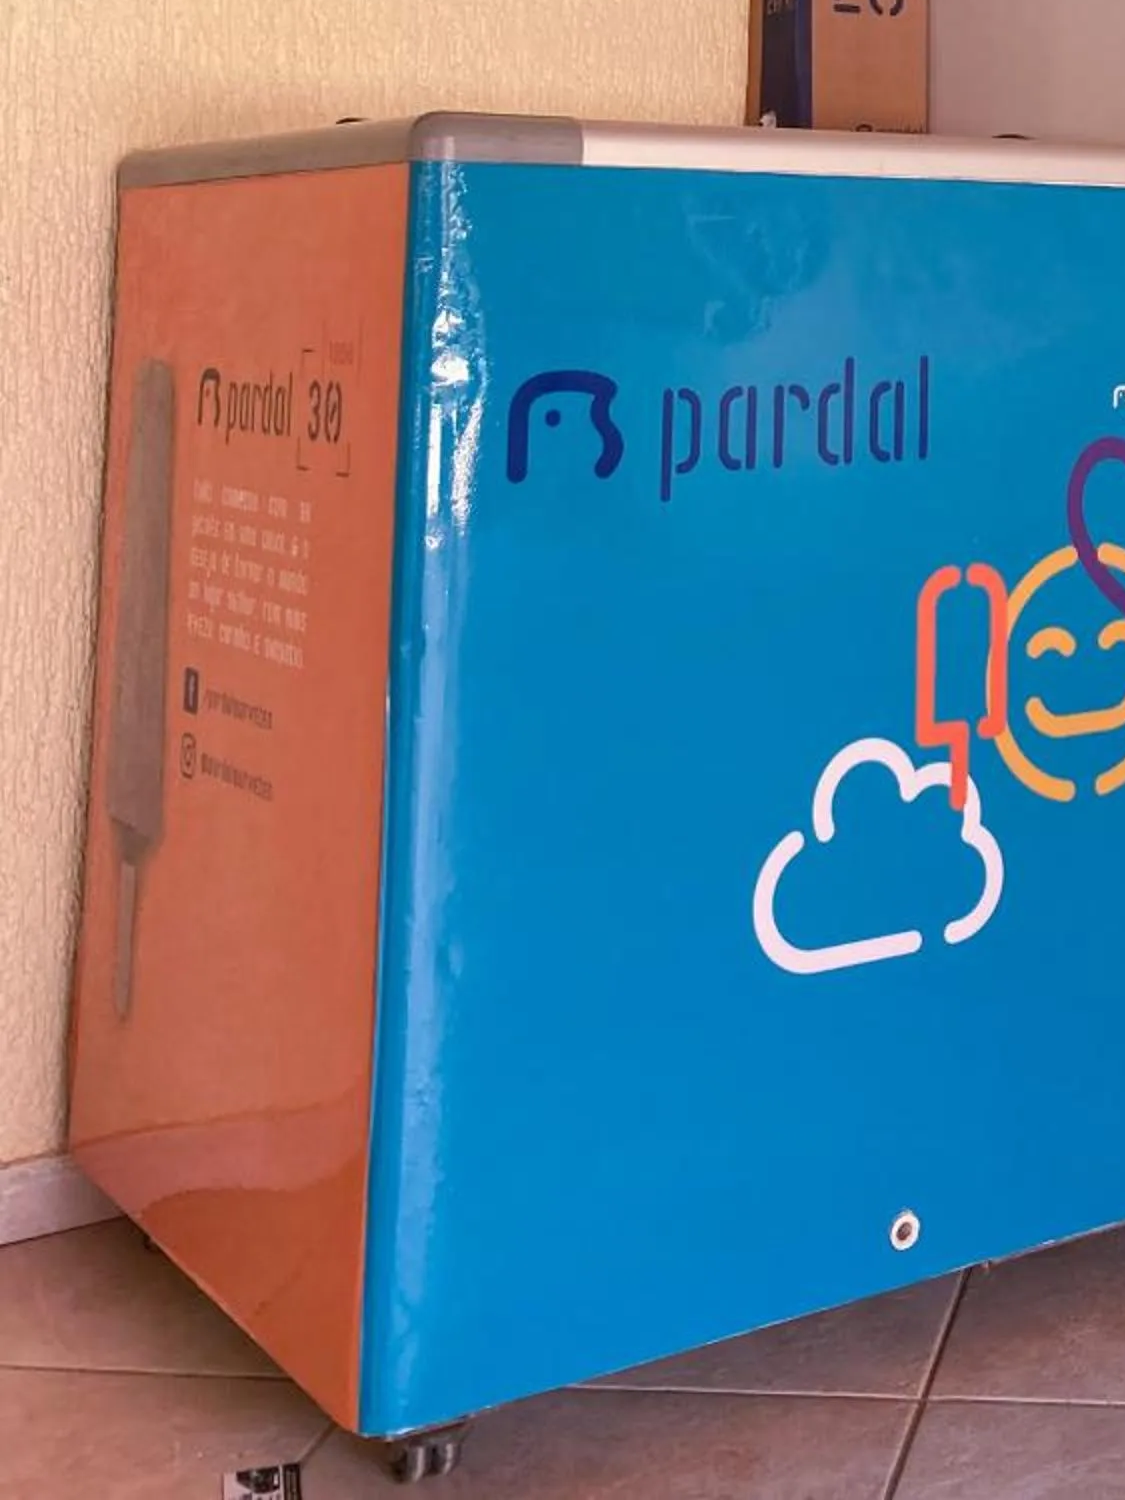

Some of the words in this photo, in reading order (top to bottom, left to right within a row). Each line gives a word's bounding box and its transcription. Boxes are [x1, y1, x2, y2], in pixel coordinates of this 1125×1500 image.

[225, 371, 293, 445] pardal
[307, 379, 343, 444] 30
[659, 354, 930, 502] pardal
